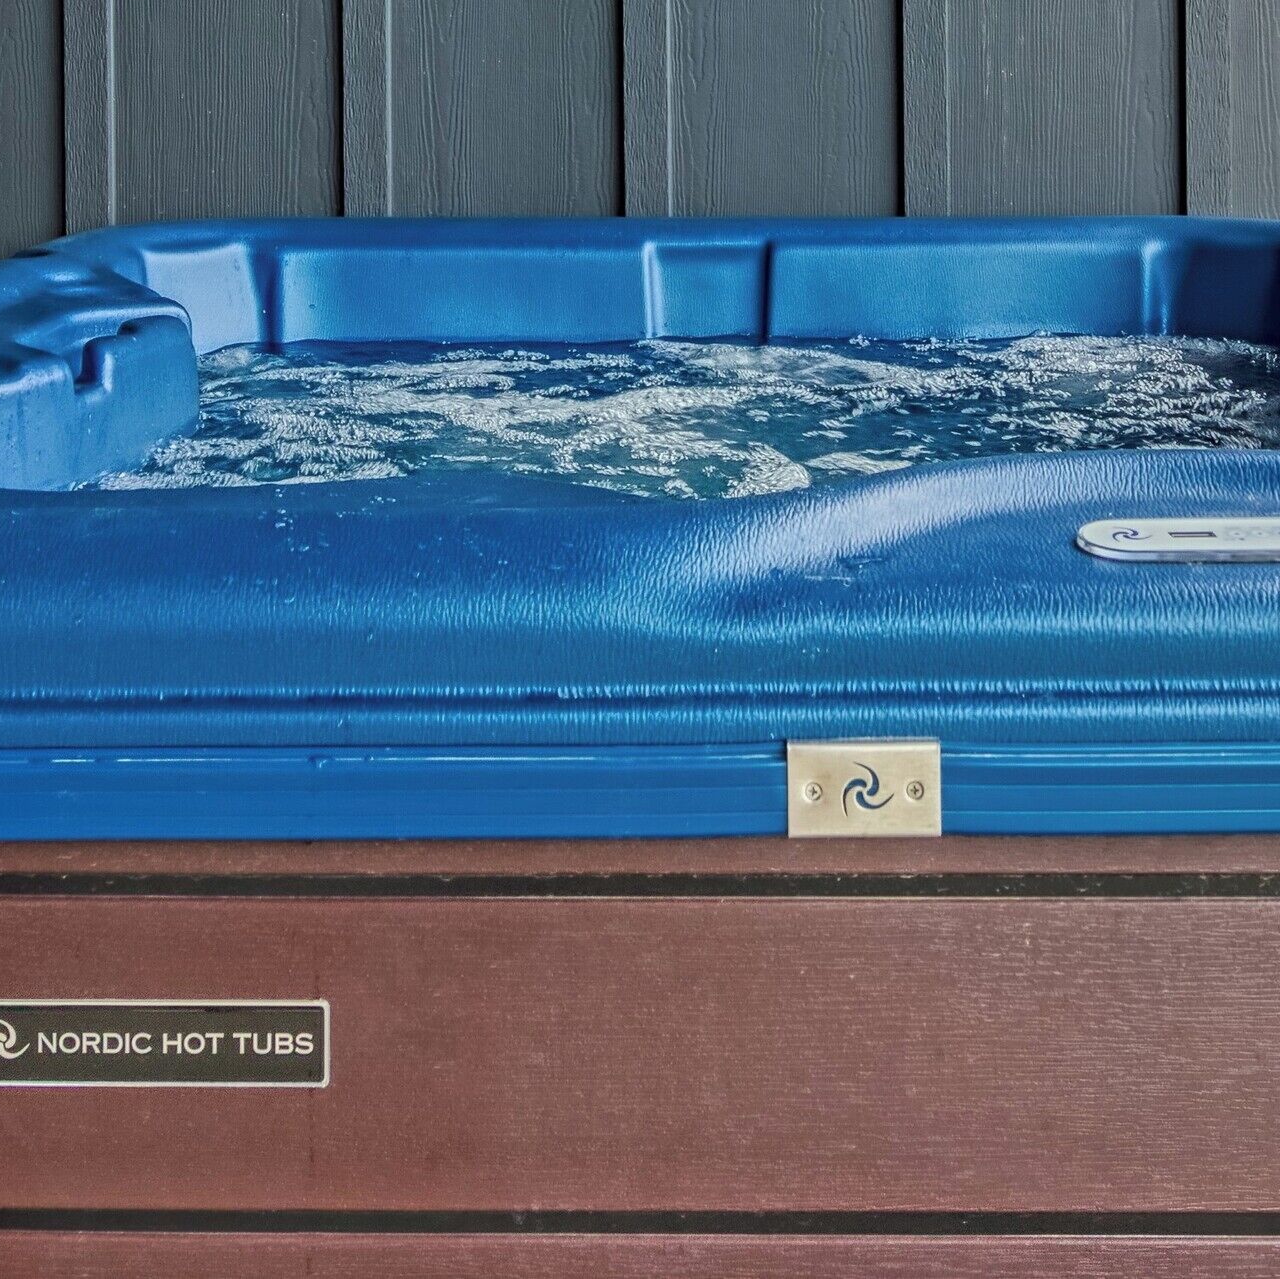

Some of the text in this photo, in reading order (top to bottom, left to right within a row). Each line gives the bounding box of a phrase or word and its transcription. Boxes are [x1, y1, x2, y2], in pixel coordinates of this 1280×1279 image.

[37, 1032, 314, 1055] NORDIC HOT TUBS
